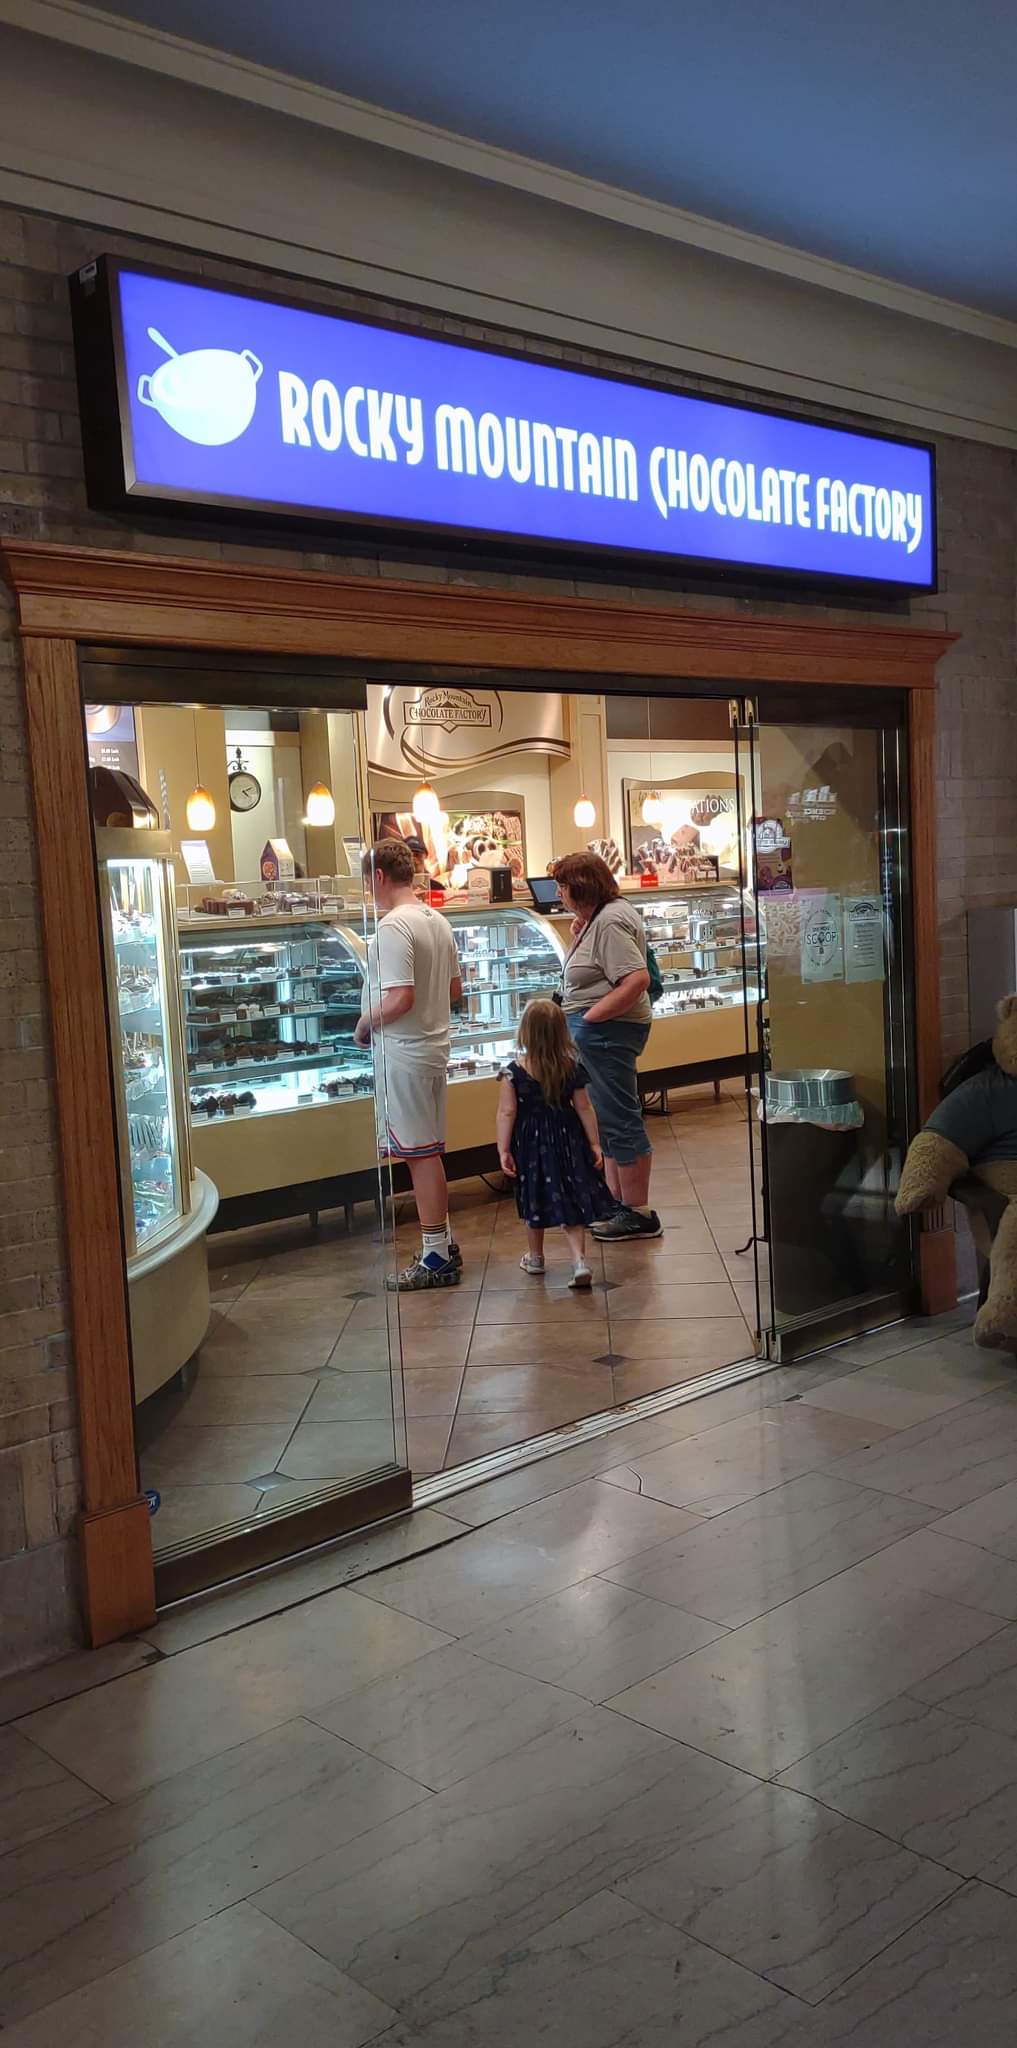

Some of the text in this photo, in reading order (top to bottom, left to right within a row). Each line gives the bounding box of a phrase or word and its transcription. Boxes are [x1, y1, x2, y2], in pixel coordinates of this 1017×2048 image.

[278, 370, 923, 554] ROCKY MOUNTAIN CHOCOLATE FACTORY
[424, 690, 473, 708] Rocky Mountain
[408, 705, 487, 722] CHOCOLATE FACTORY
